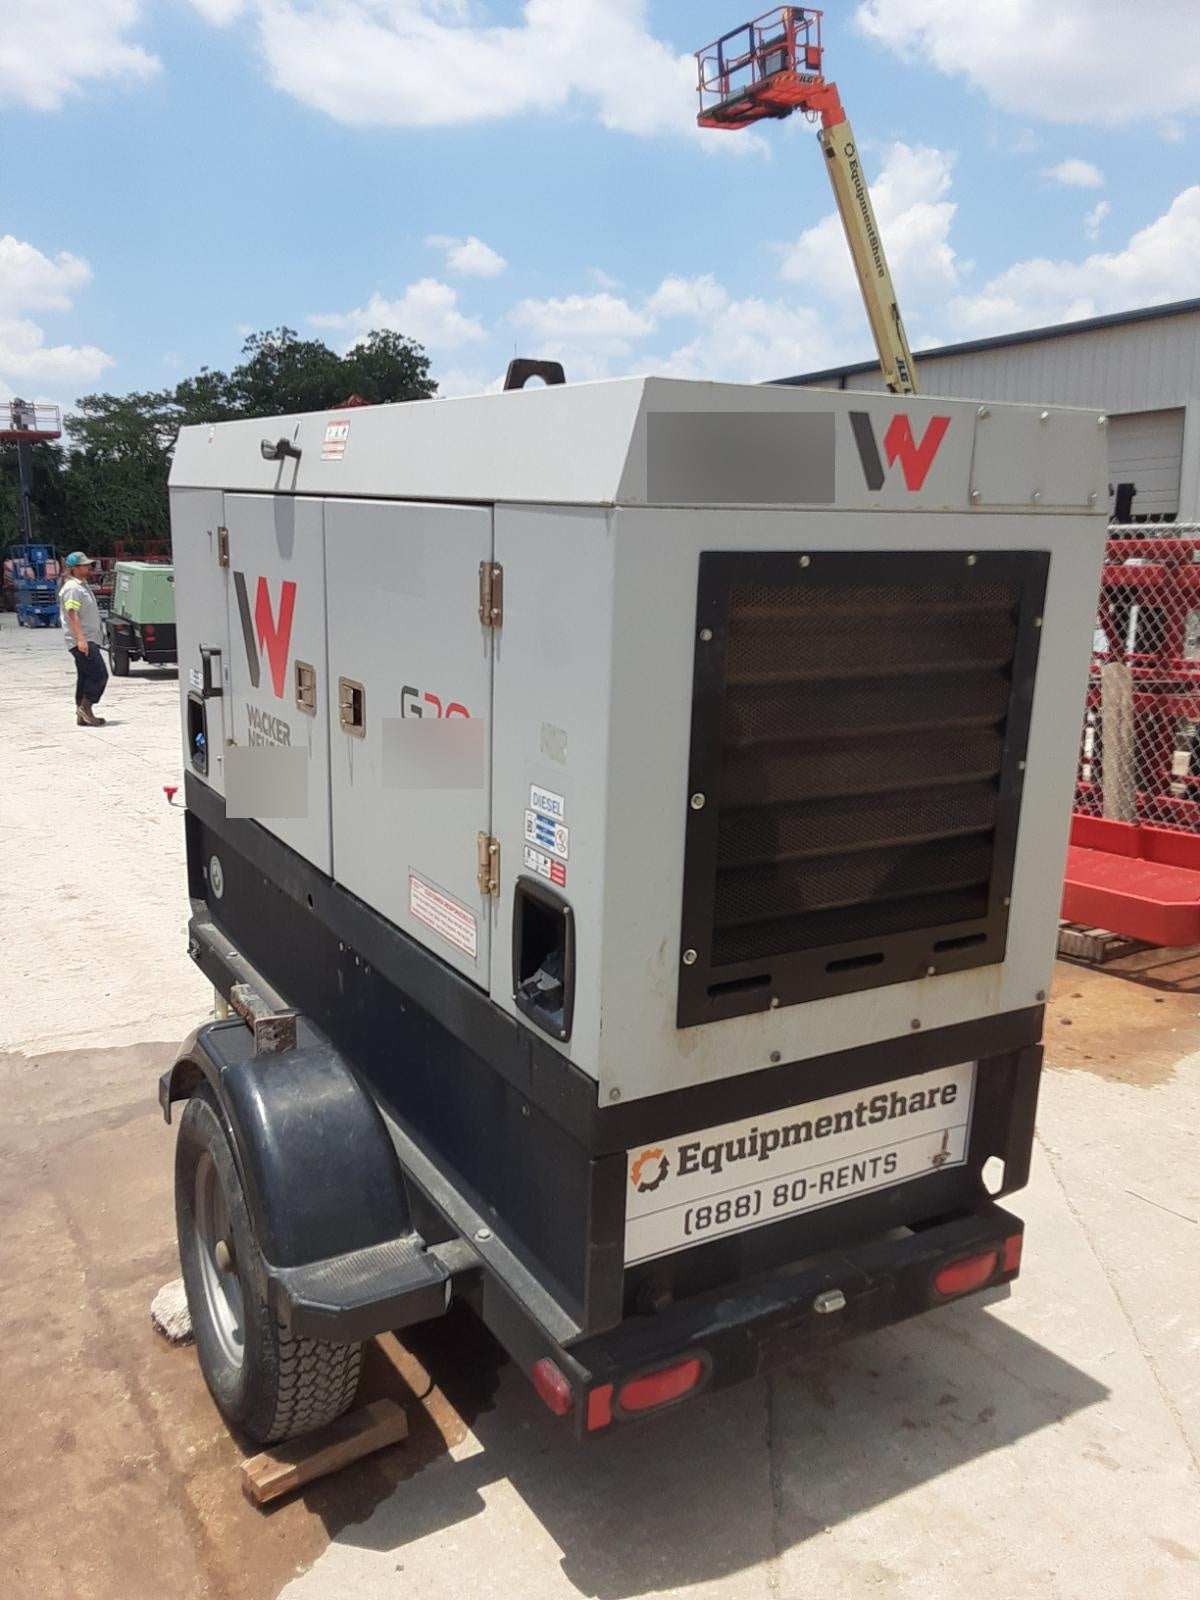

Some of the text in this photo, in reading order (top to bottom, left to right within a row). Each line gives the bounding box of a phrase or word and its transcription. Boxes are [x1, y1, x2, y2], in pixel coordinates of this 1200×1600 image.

[849, 159, 885, 278] EquipmentShare
[246, 703, 291, 746] WACKER
[532, 792, 562, 817] DIESEL
[676, 1083, 958, 1176] EquipmentShare
[684, 1152, 898, 1236] (888) 80-RENTS
